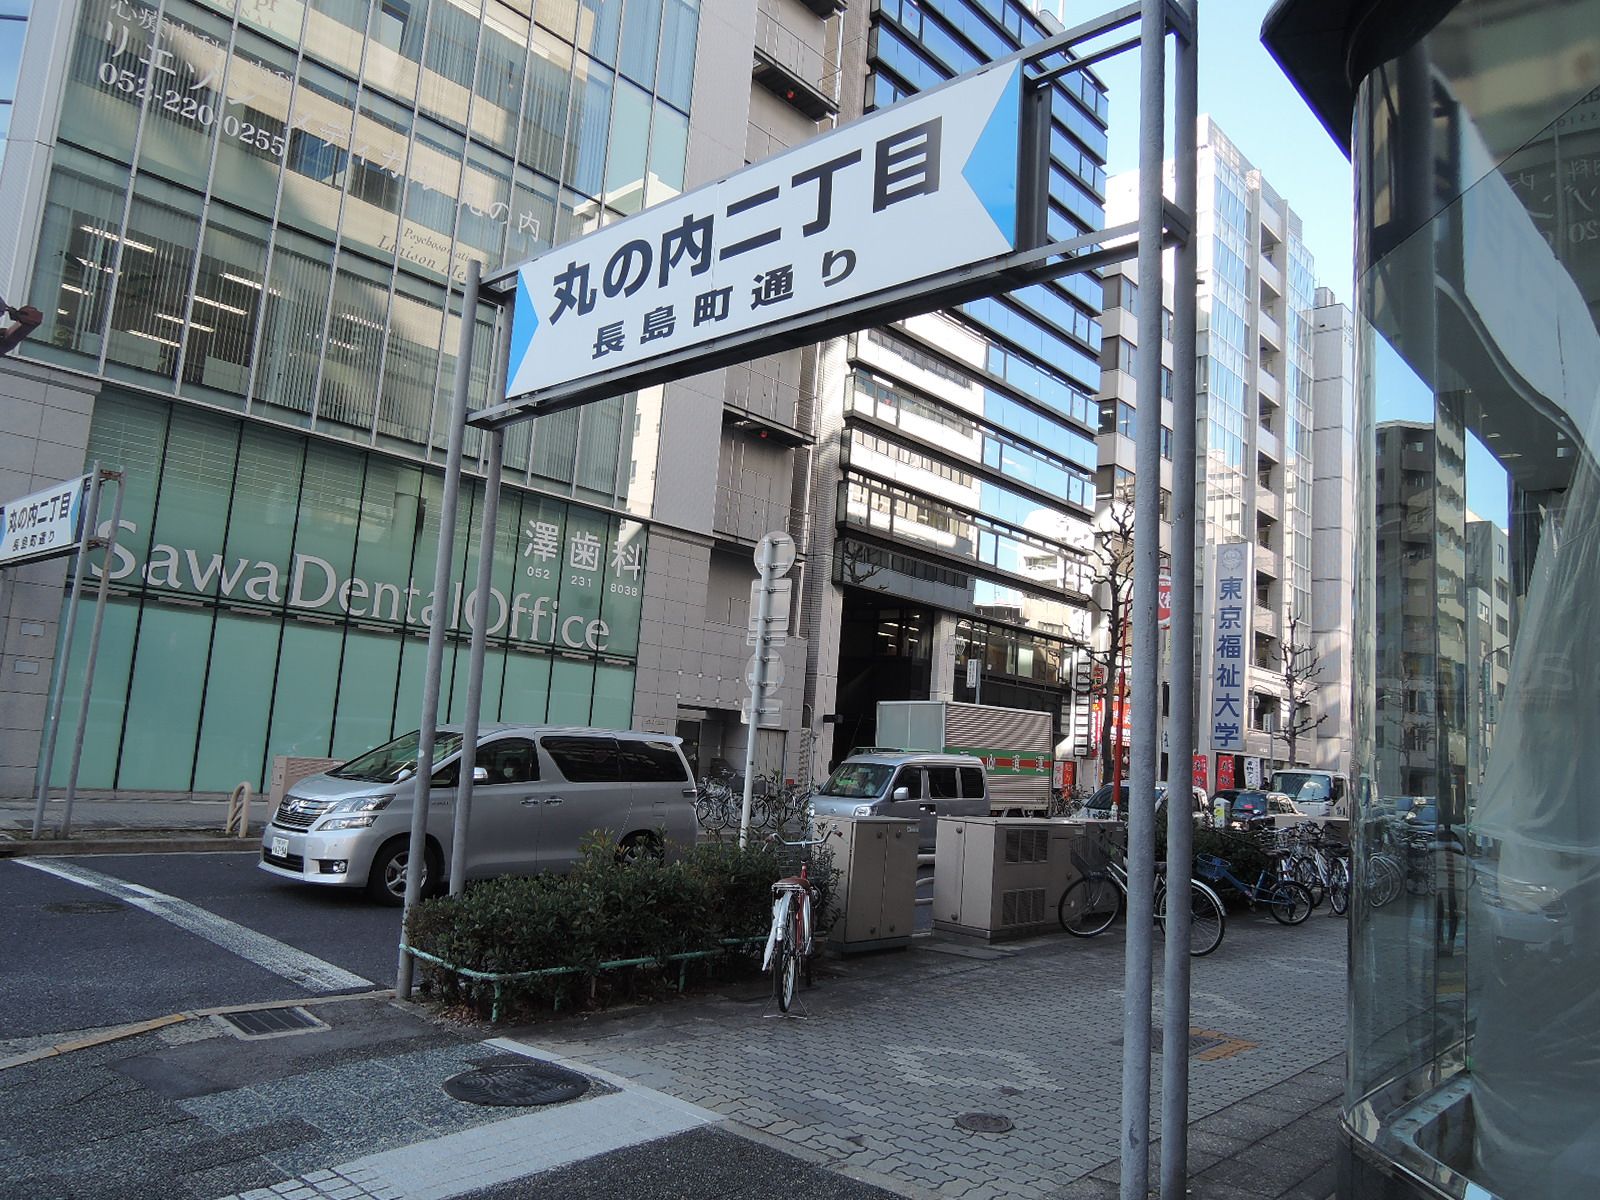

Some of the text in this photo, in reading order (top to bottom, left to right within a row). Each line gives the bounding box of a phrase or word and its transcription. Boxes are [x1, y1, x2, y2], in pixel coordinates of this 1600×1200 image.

[100, 62, 286, 157] 052-220-0255
[548, 115, 943, 326] 丸の内二丁目
[591, 248, 858, 361] 長島町通り
[7, 491, 72, 534] 丸の内二丁目
[524, 520, 641, 582] 澤歯科
[526, 566, 638, 597] 052 231 8038
[1214, 575, 1244, 748] 東京福祉大学
